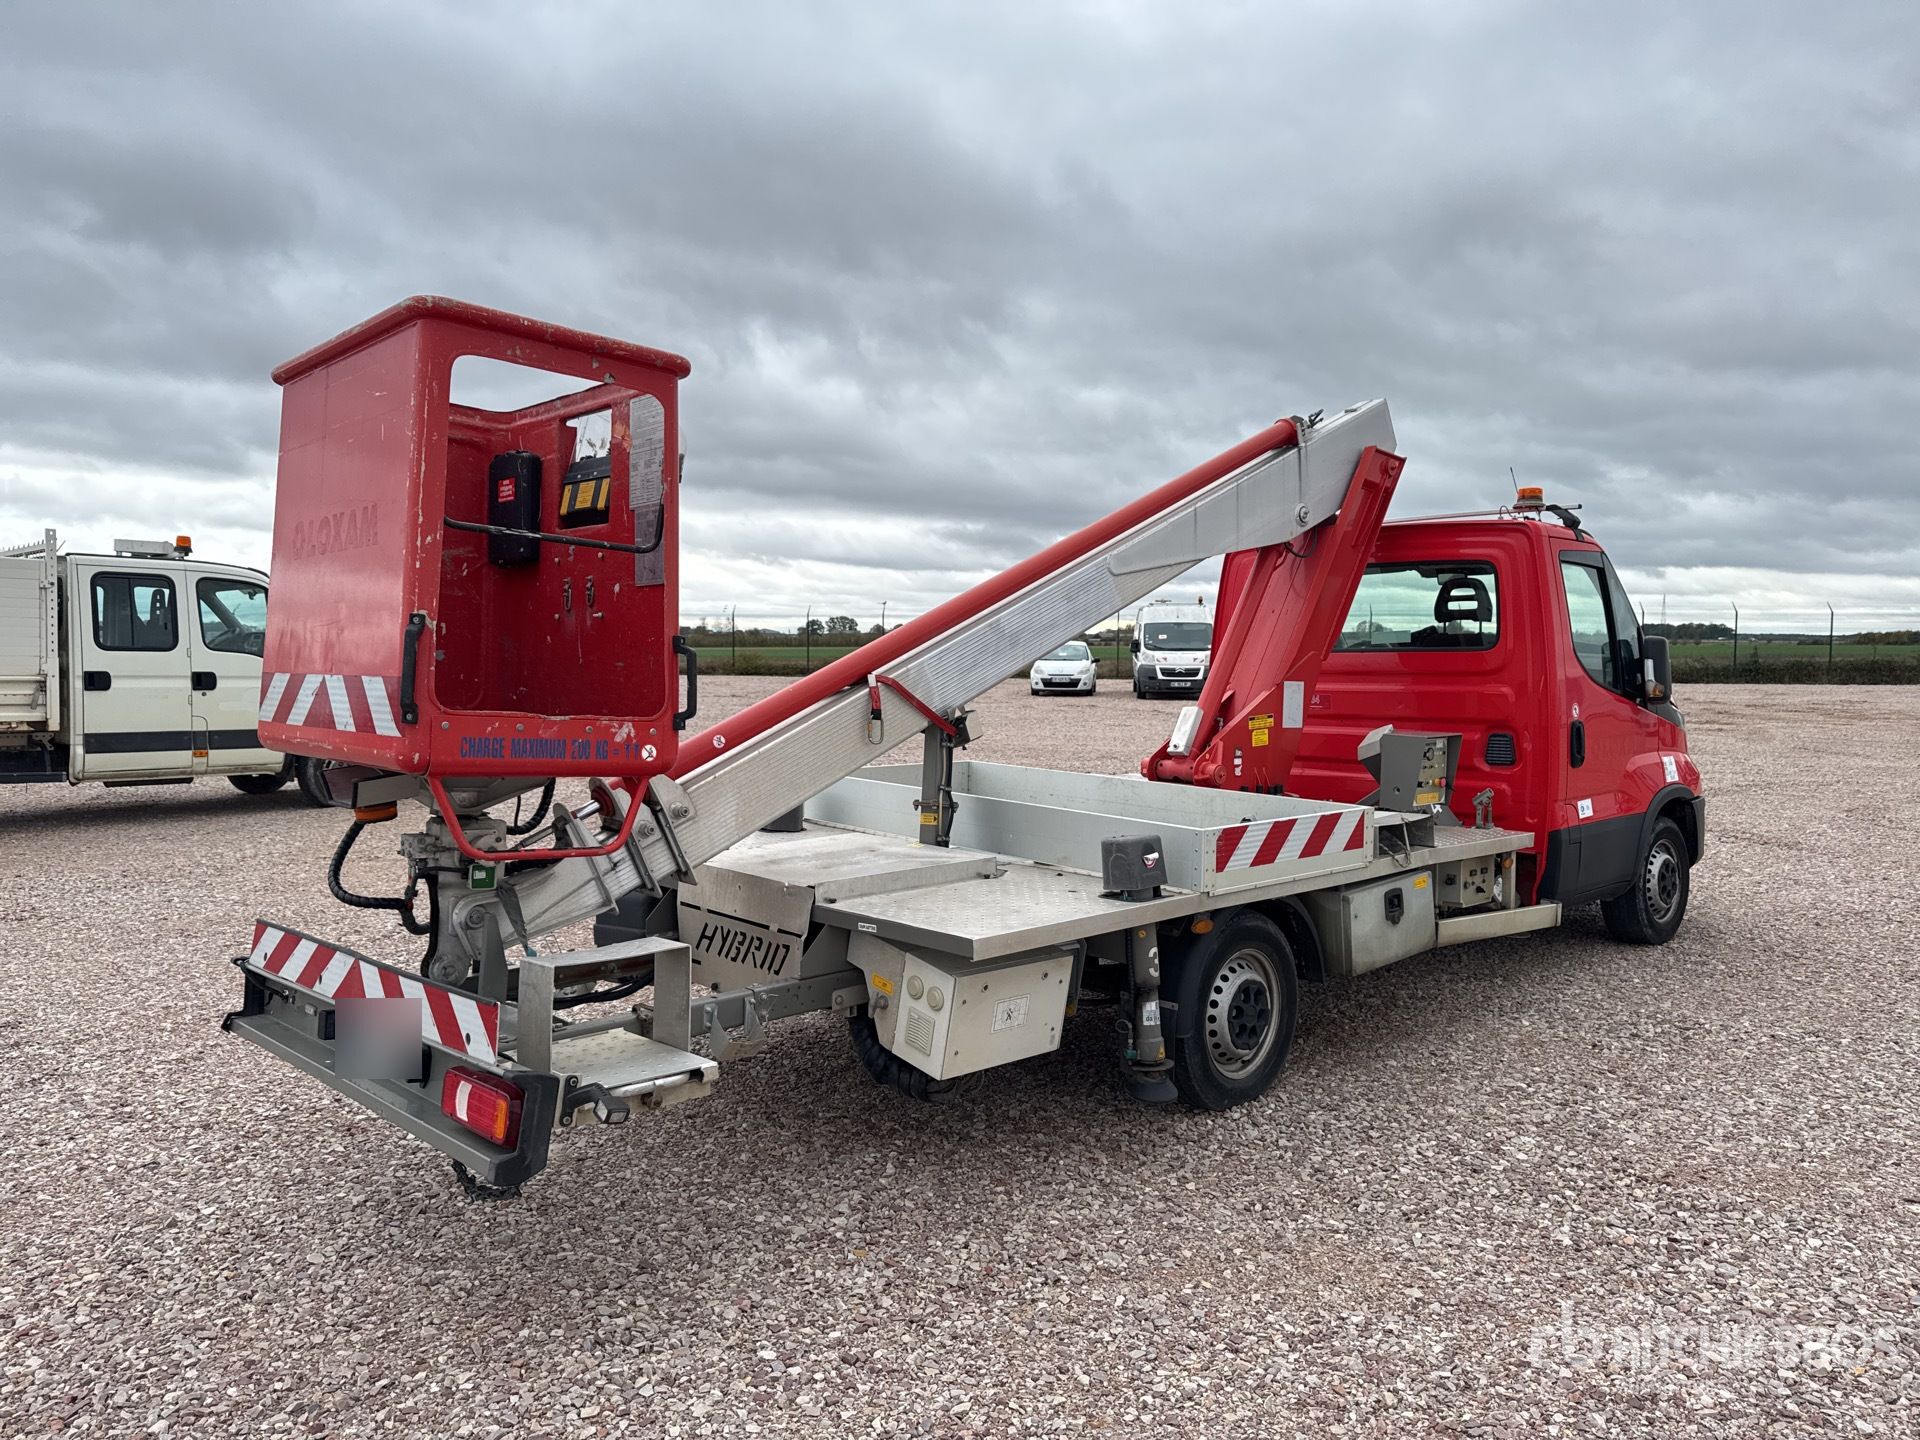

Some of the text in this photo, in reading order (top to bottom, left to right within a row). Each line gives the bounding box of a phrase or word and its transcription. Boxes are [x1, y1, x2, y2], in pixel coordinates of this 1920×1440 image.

[460, 736, 505, 759] CHARGE
[510, 737, 567, 760] MAXIMUM
[571, 738, 591, 760] 200
[595, 739, 609, 761] KG
[695, 922, 791, 976] HYBRID
[1148, 946, 1160, 978] 3
